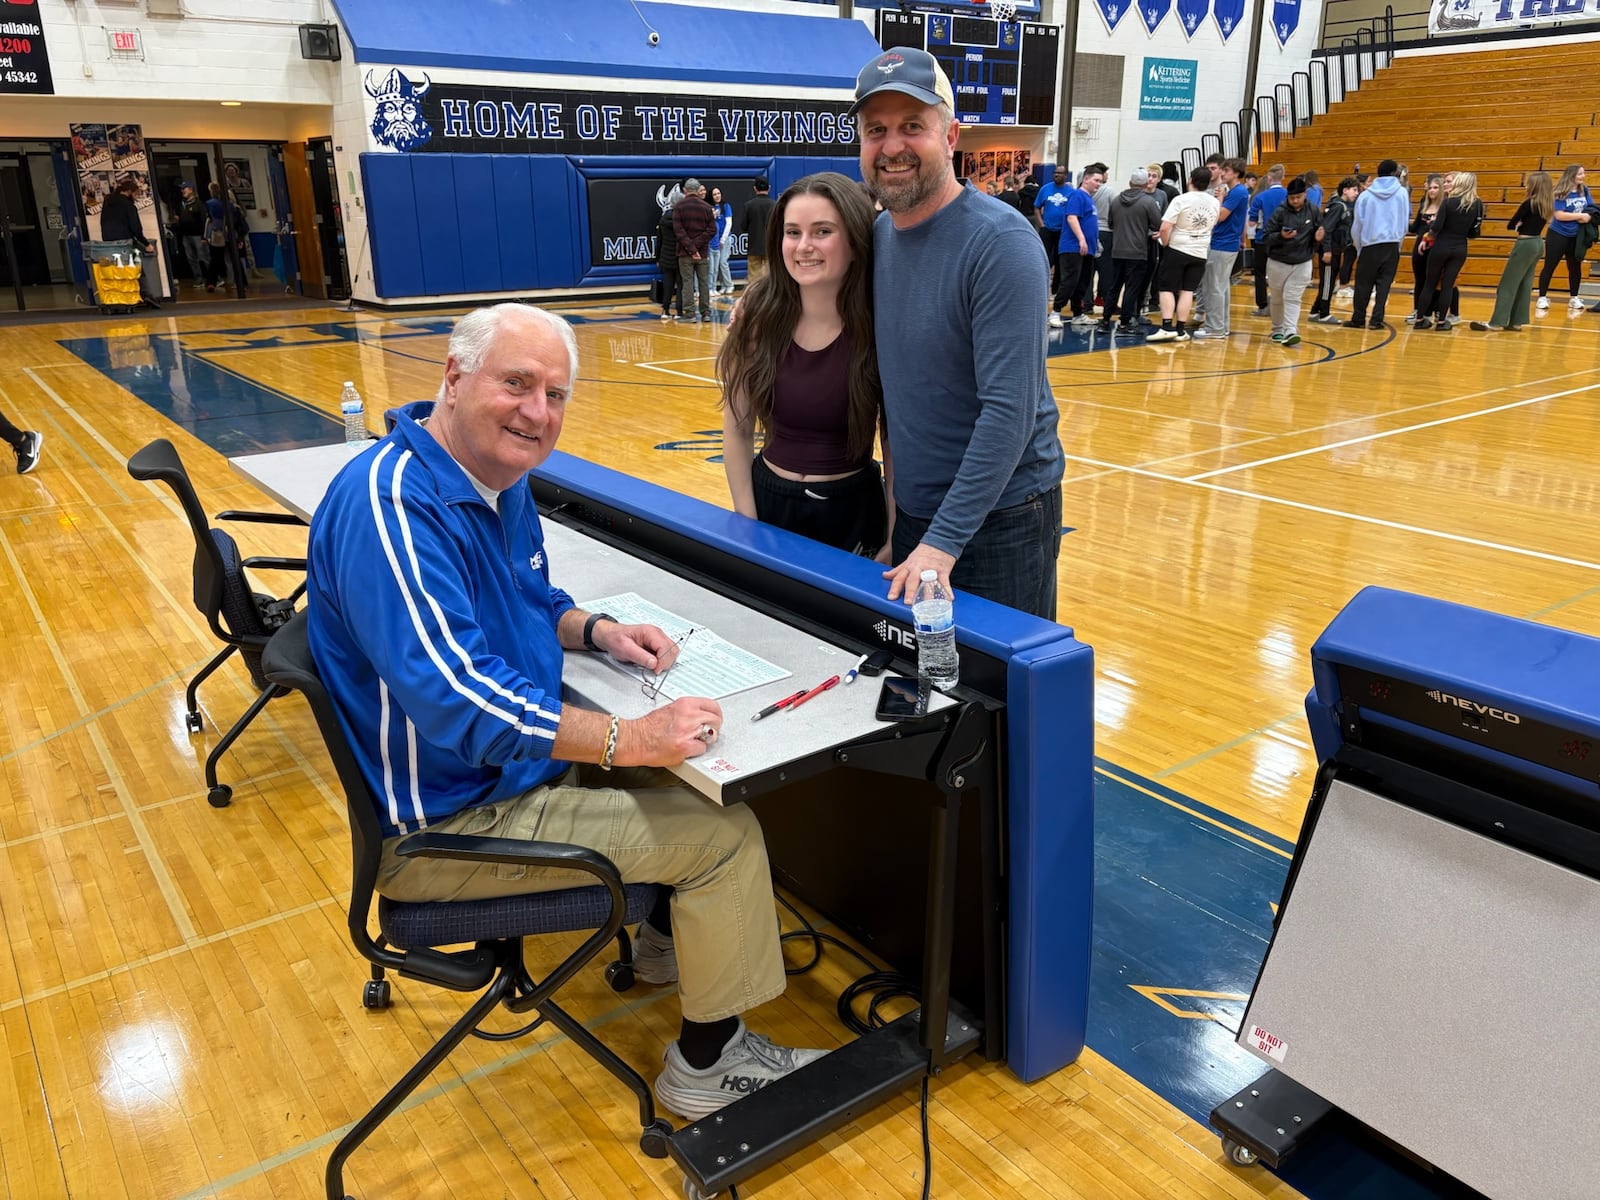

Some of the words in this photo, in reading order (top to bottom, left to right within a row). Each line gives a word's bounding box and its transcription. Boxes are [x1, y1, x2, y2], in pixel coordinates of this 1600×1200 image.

[912, 16, 921, 24] PTS
[114, 33, 135, 48] EXIT
[965, 53, 983, 61] PERIOD
[5, 71, 38, 83] 45342
[1158, 65, 1191, 77] KETTERING
[957, 85, 975, 93] PLAYER
[977, 86, 988, 94] FOUL
[1002, 87, 1016, 95] FOULS
[1152, 95, 1163, 103] Care
[440, 99, 564, 139] HOME
[576, 104, 622, 140] OF
[635, 106, 707, 141] THE
[718, 109, 855, 143] VIKINGS
[79, 151, 110, 169] VIKINGS
[114, 151, 146, 169] VIKINGS
[1442, 693, 1520, 724] NEVCO
[1254, 1027, 1266, 1040] DO
[1266, 1034, 1283, 1049] NOT
[1259, 1041, 1273, 1054] SIT
[720, 1075, 774, 1093] HOK
